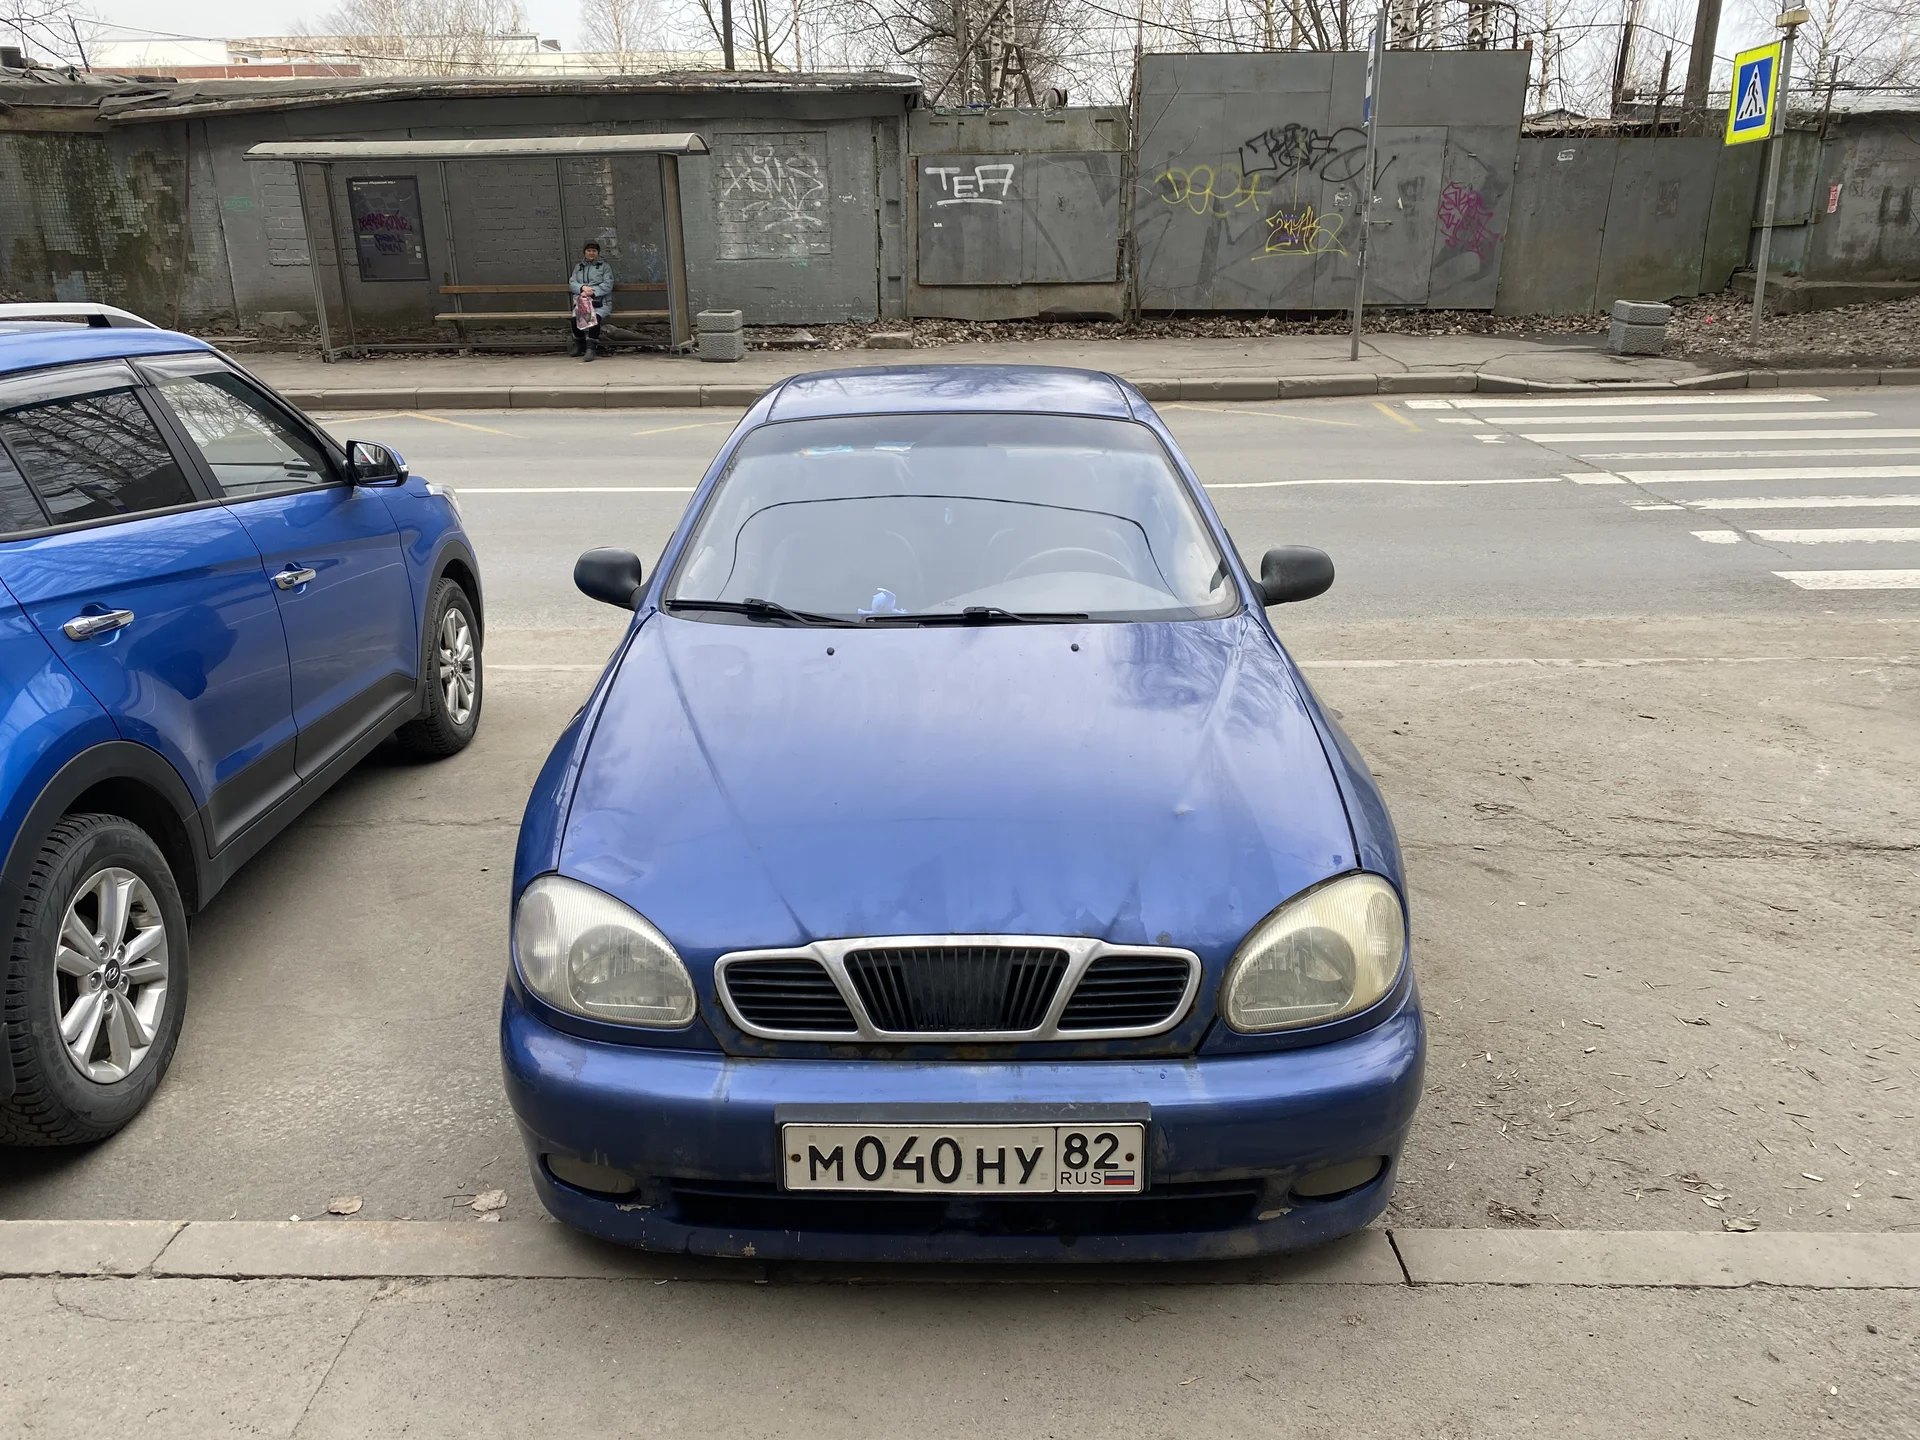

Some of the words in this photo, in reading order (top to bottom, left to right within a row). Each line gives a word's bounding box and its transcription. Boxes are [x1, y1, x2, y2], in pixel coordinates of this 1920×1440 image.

[925, 164, 1014, 197] TEA
[1062, 1132, 1119, 1170] 82
[1059, 1171, 1101, 1185] RUS
